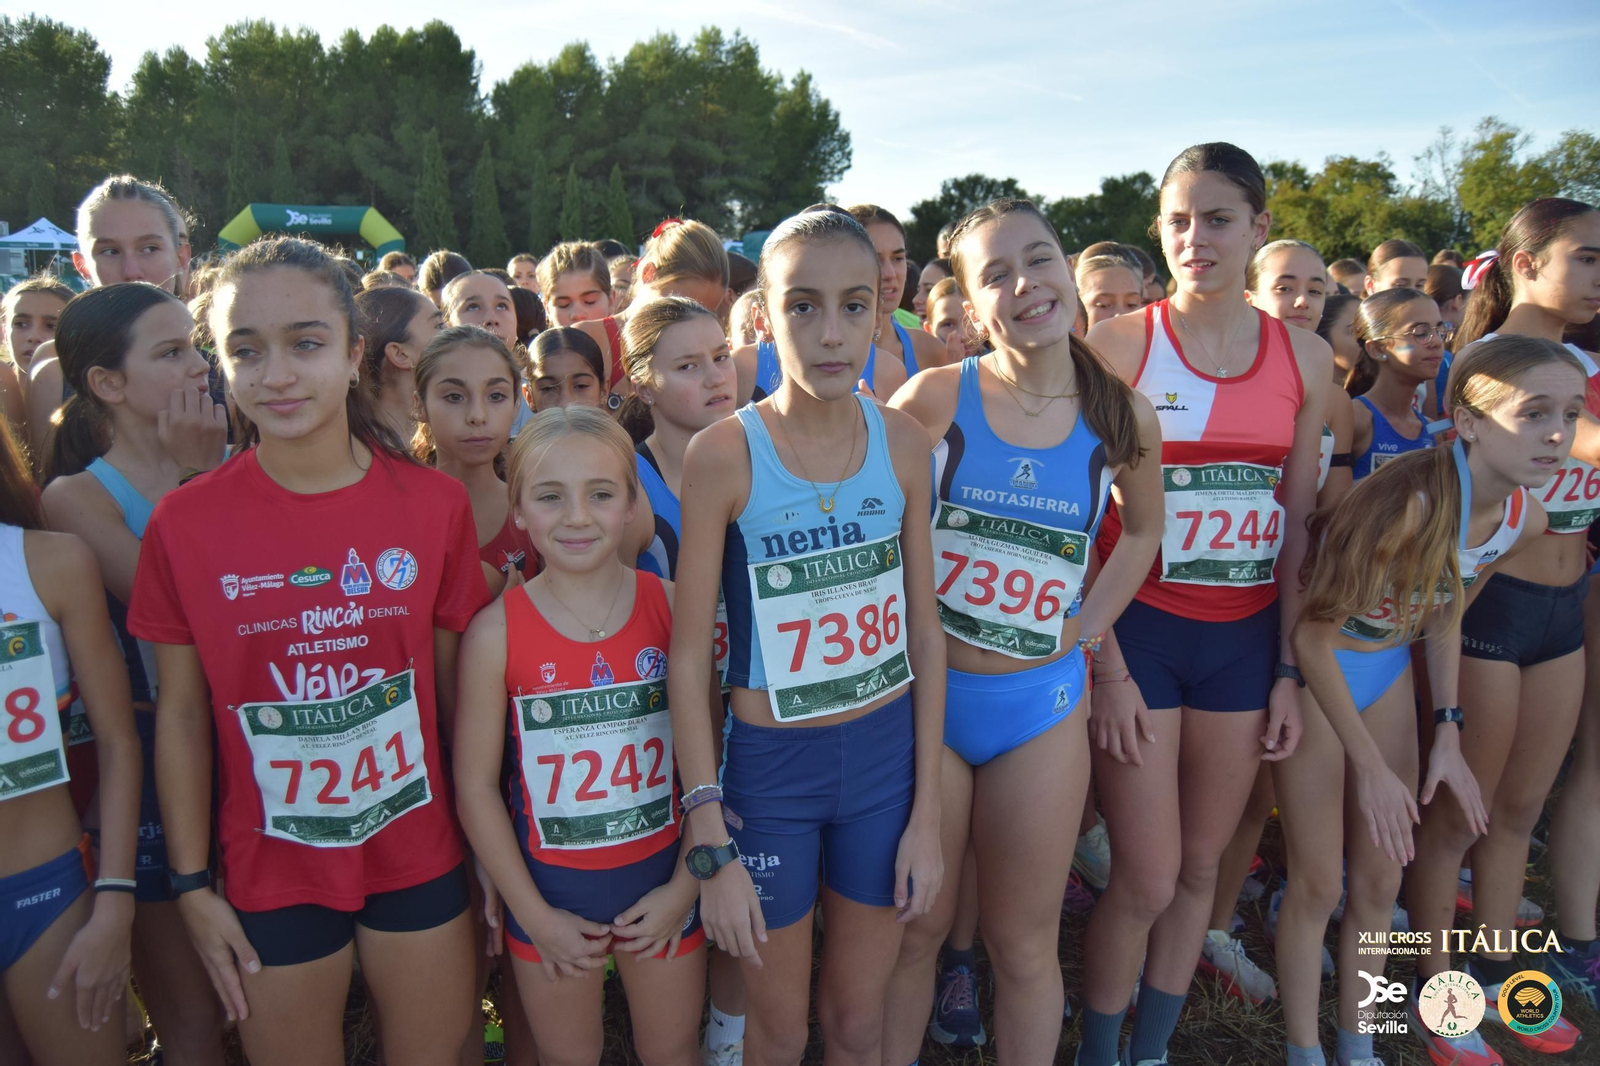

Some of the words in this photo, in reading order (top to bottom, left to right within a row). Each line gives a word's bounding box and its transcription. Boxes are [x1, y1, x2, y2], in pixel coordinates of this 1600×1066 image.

[1378, 442, 1398, 451] vive
[1201, 466, 1264, 482] ITÁLICA
[961, 486, 1080, 516] TROTASIERRA
[761, 515, 866, 558] nerja
[1176, 510, 1279, 551] 7244
[990, 540, 1020, 551] GUZMAN
[1021, 548, 1052, 560] AGUILERA
[802, 550, 880, 580] ITÁLICA
[290, 572, 331, 584] Cesurca
[936, 551, 1066, 622] 7396
[811, 589, 826, 598] IRIS
[827, 583, 857, 595] ILLANES
[815, 591, 854, 604] TROPS-CUEVA
[238, 617, 298, 636] CLINICAS
[368, 606, 410, 619] DENTAL
[777, 594, 900, 672] 7386
[287, 635, 369, 656] ATLETISMO
[292, 695, 375, 726] ITÁLICA
[561, 691, 641, 716] ITÁLICA
[332, 728, 361, 741] MILLAN
[361, 719, 378, 730] RIOS
[553, 725, 595, 735] ESPERANZA
[596, 721, 627, 731] CAMPOS
[332, 737, 355, 748] RINCON
[270, 731, 415, 805] 7241
[537, 737, 667, 805] 7242
[739, 853, 781, 871] erja
[16, 888, 61, 909] FASTER
